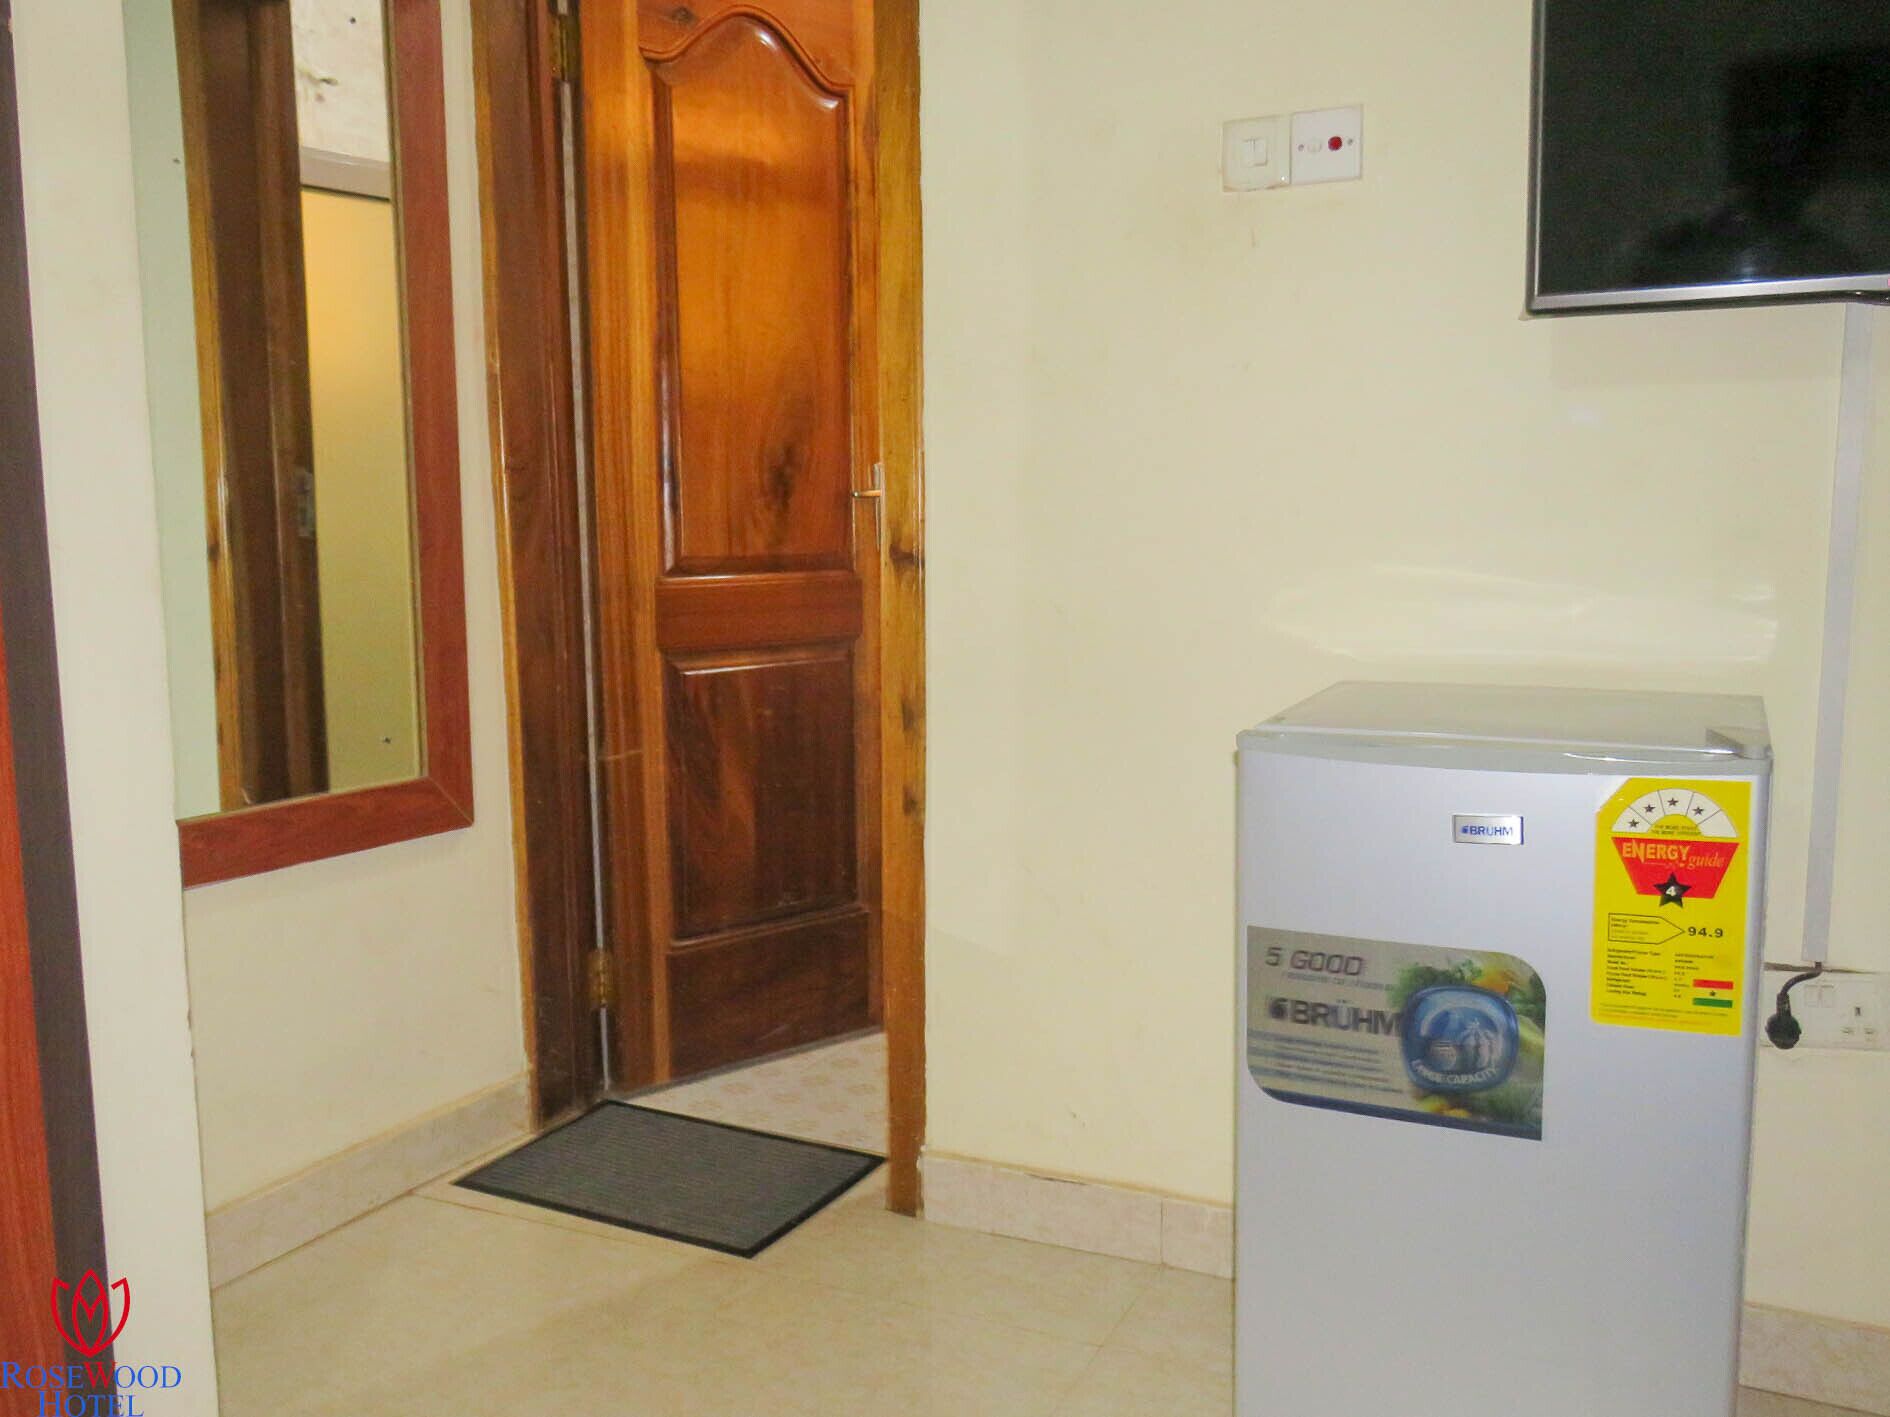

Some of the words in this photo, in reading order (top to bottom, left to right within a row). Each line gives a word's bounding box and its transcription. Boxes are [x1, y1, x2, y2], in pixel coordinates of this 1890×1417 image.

[1621, 840, 1690, 863] ENERGY
[1688, 852, 1725, 869] guide
[1665, 886, 1676, 897] 4
[1687, 926, 1724, 939] 94.9
[1265, 946, 1283, 967] 5
[1290, 950, 1363, 976] GOOD
